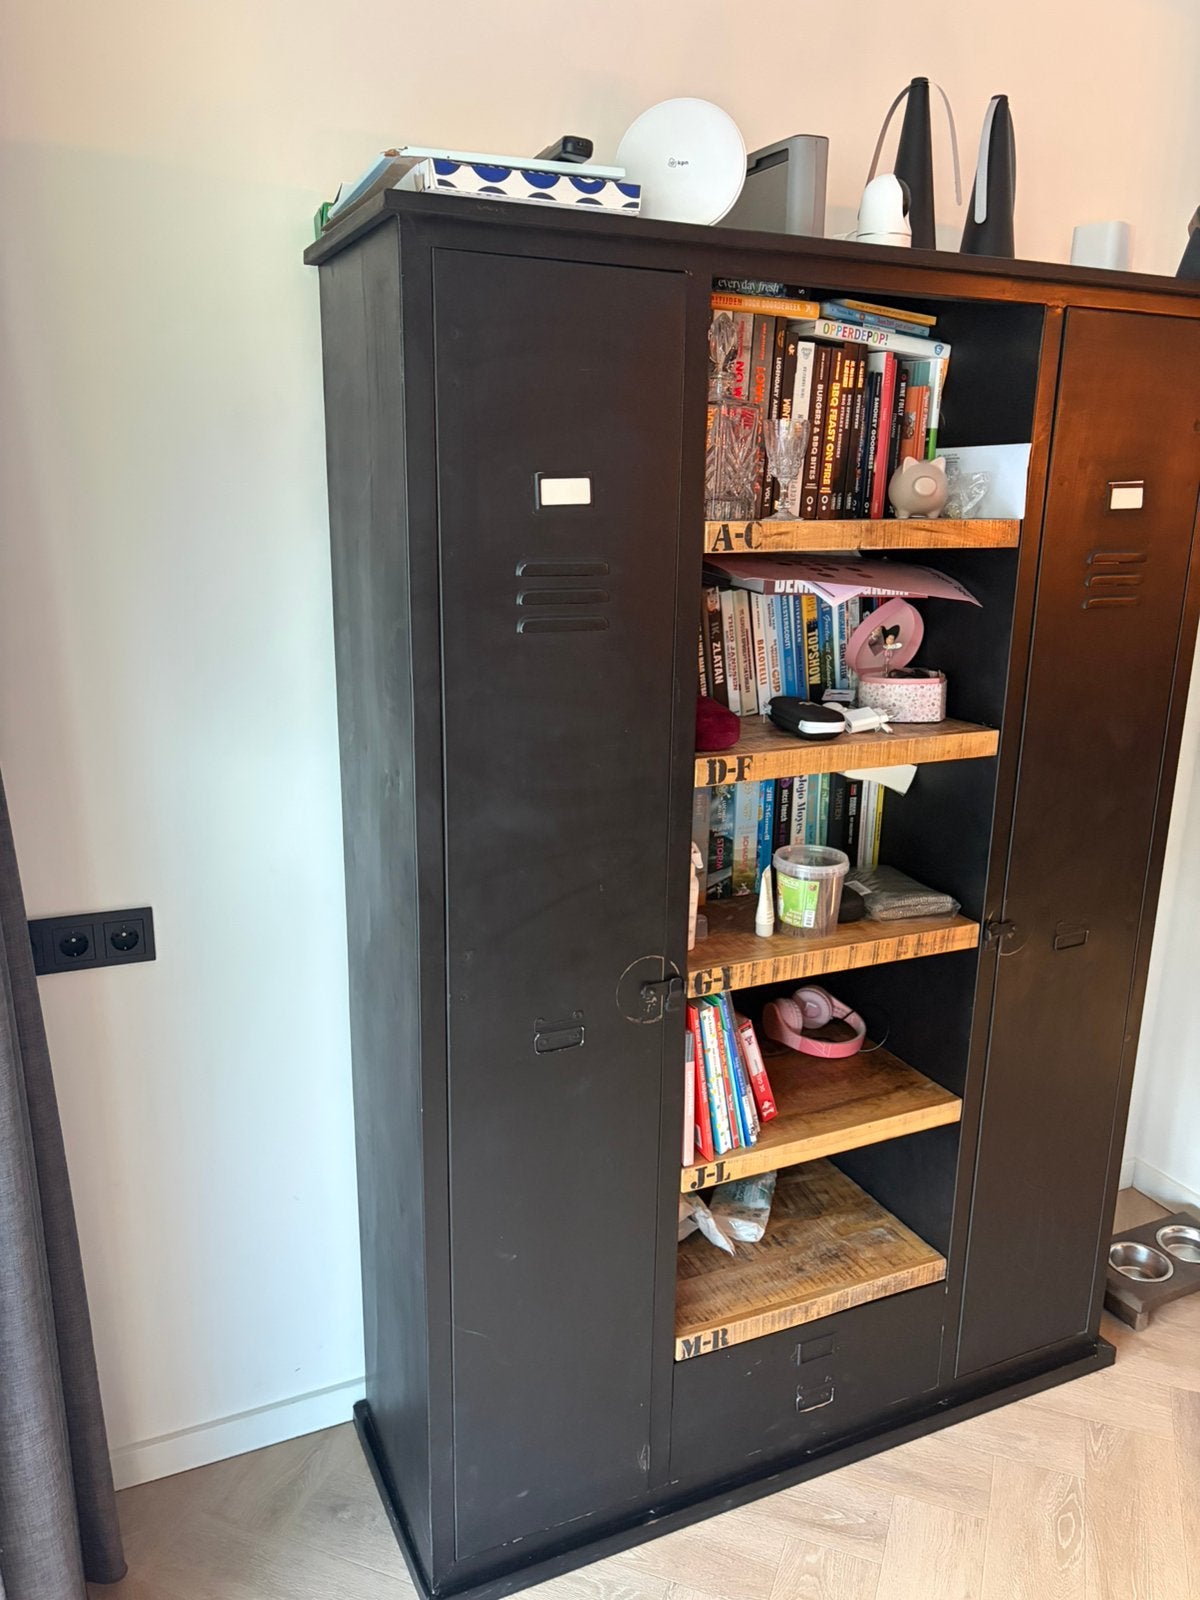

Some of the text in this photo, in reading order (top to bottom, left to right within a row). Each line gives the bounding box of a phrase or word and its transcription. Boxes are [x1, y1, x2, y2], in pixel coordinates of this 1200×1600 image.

[718, 280, 779, 293] everyday fresh
[822, 322, 889, 346] OPPERDEPOP!
[815, 384, 823, 425] BURGERS
[831, 382, 840, 407] BBQ
[828, 408, 839, 441] FEAST
[826, 443, 833, 461] ON
[824, 462, 832, 485] FIRE
[711, 521, 763, 552] A-C
[823, 614, 831, 641] Groeten
[713, 641, 723, 685] ZLATAN
[729, 645, 737, 691] JANSSEN
[758, 638, 766, 686] BALOTELLI
[808, 629, 820, 686] TOPSHOW
[705, 755, 753, 785] D-F
[795, 777, 807, 834] Jojo Moyes
[694, 966, 733, 995] G-I
[690, 1161, 731, 1189] J-L
[681, 1327, 729, 1359] M-R
